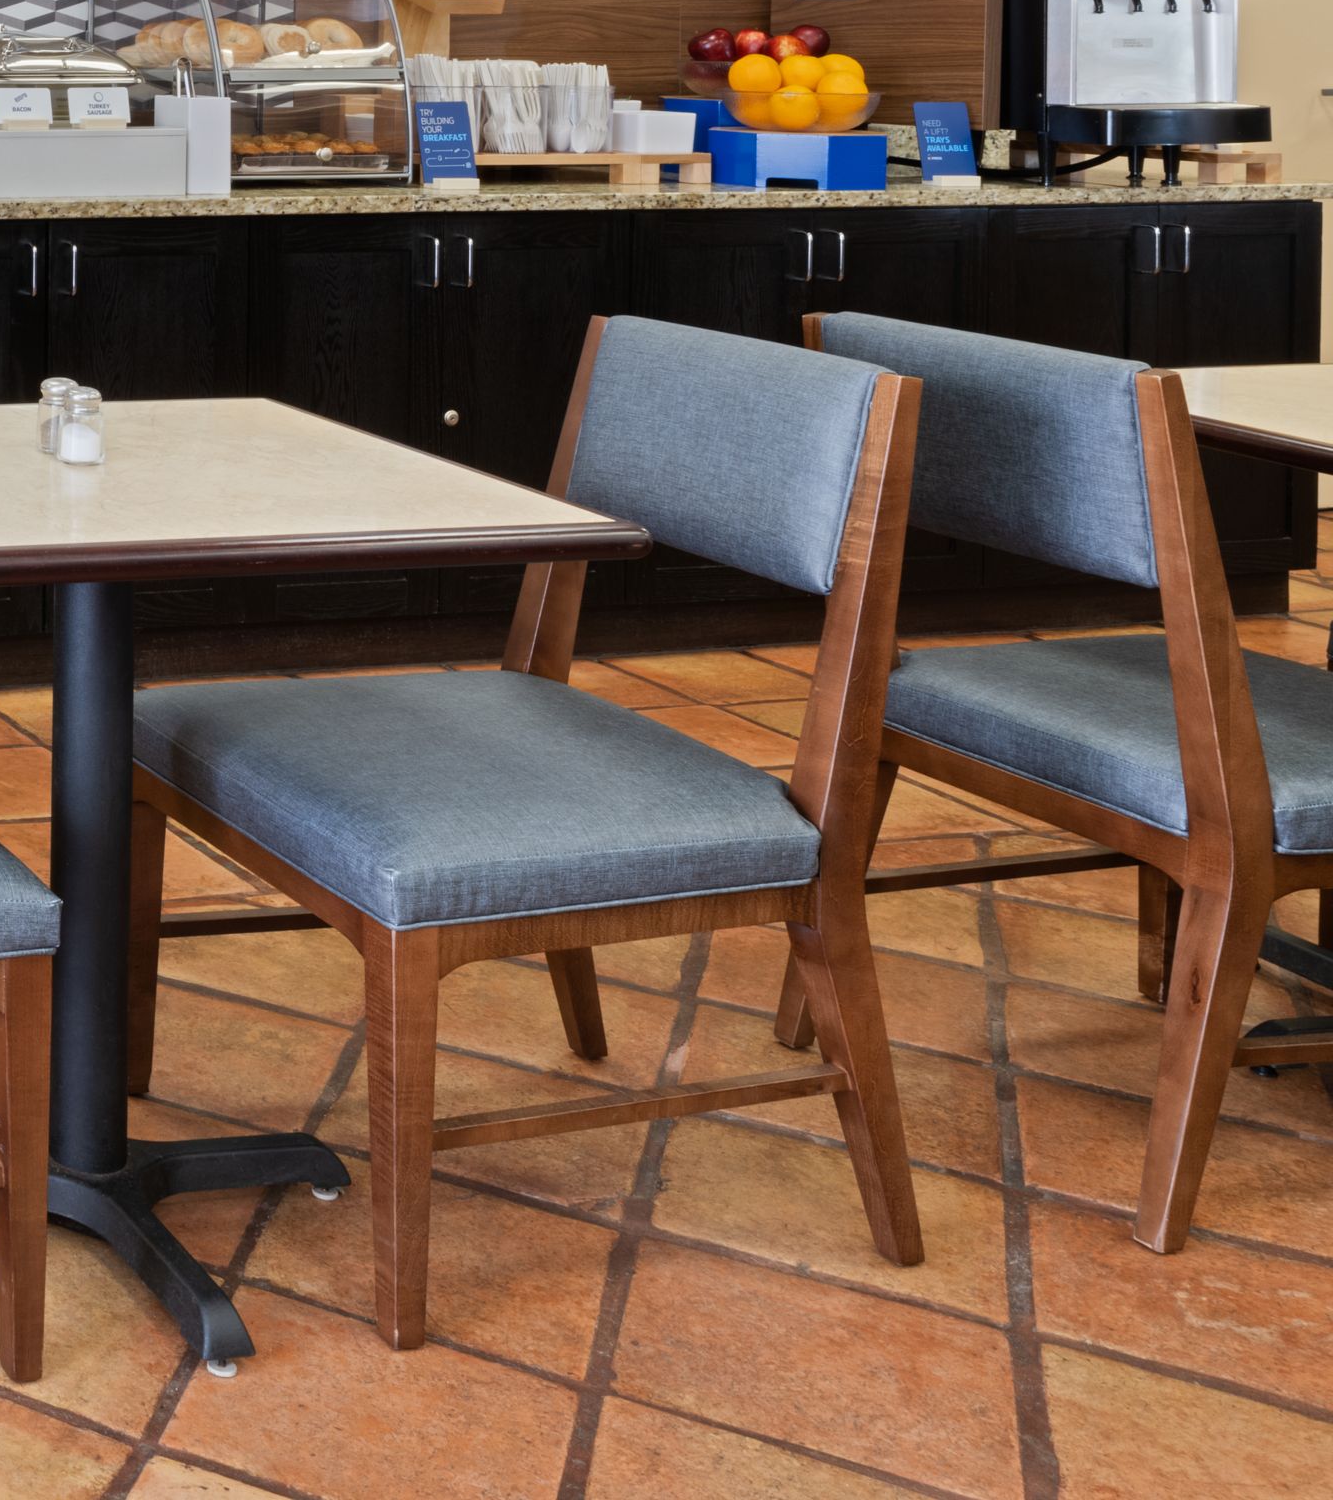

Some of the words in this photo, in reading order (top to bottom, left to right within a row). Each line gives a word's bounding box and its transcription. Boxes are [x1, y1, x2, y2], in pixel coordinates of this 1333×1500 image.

[419, 108, 434, 117] TRY
[421, 117, 455, 125] BUILDING
[922, 119, 941, 127] NEED
[422, 125, 443, 133] YOUR
[423, 133, 467, 141] BREAKFAST
[925, 136, 950, 144] TRAYS
[927, 144, 969, 152] AVAILABLE
